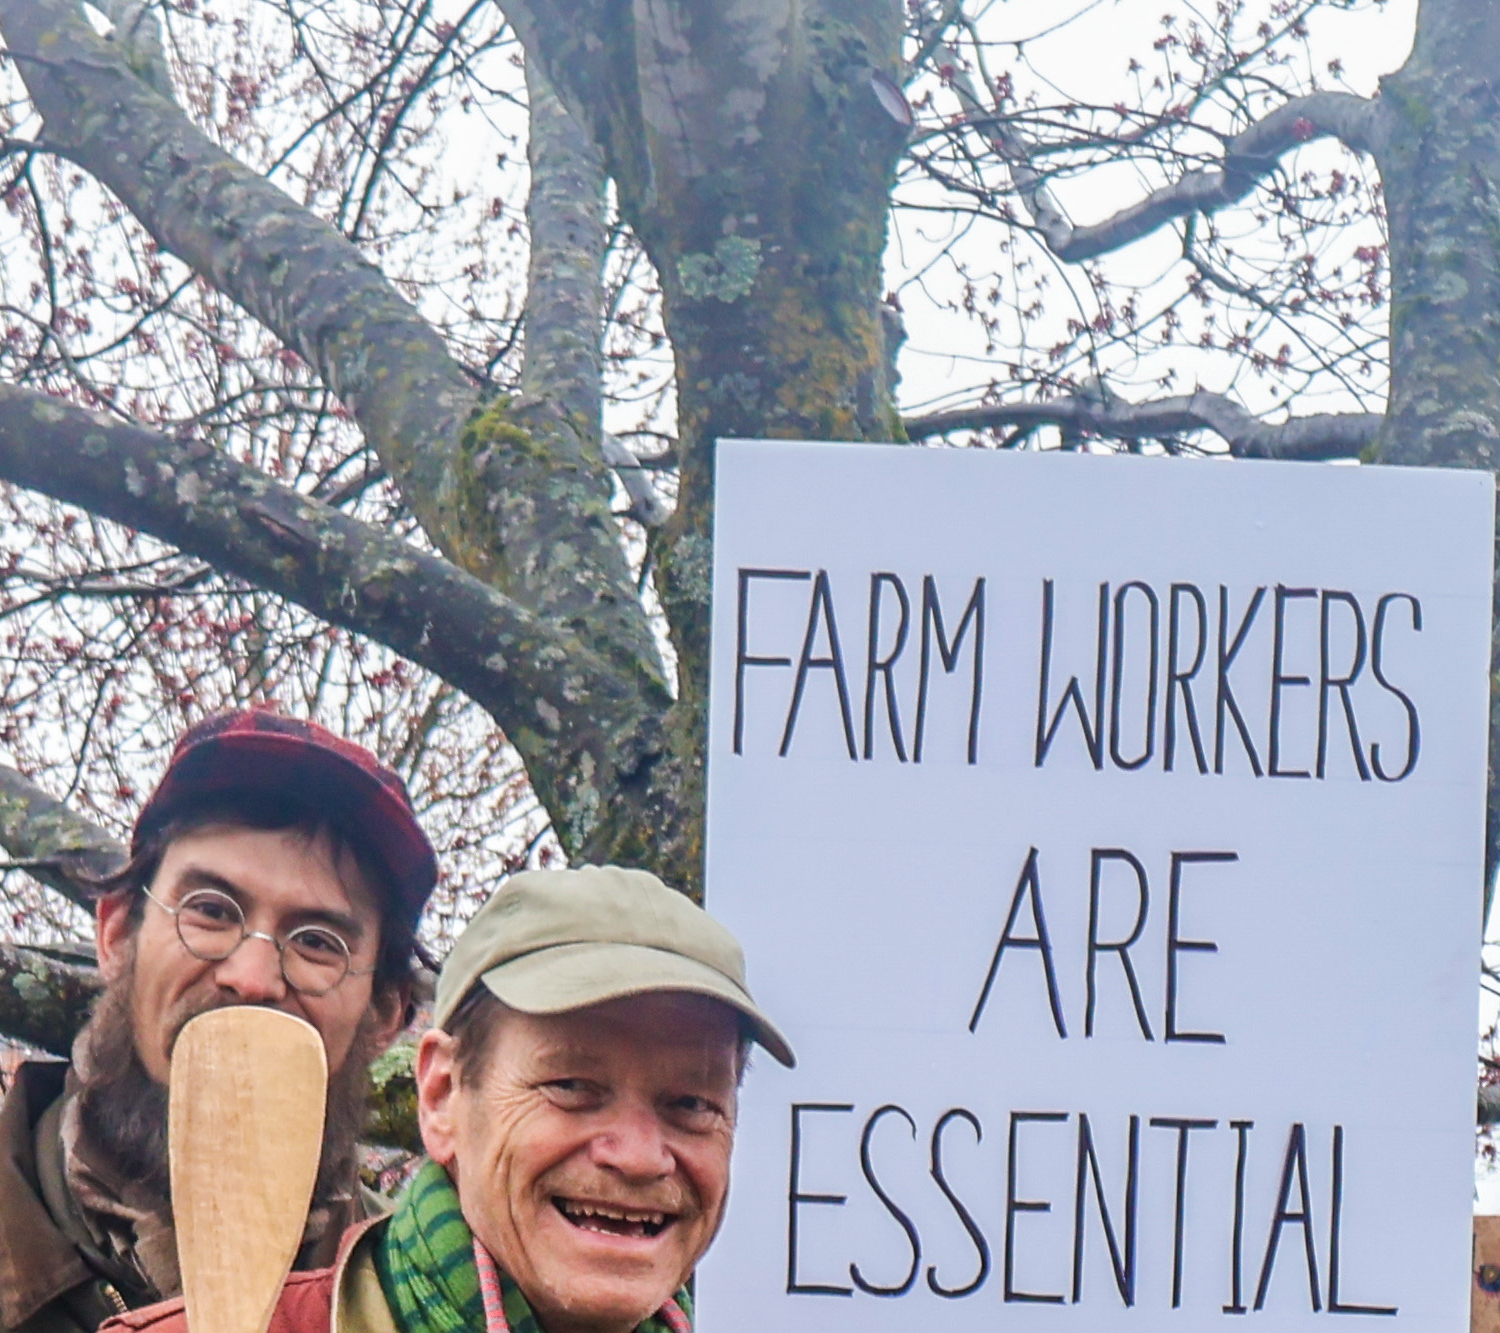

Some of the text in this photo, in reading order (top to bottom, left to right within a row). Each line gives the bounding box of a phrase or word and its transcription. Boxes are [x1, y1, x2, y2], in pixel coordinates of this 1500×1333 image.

[733, 568, 1423, 782] FARM WORKERS
[968, 846, 1240, 1044] ARE
[785, 1102, 1399, 1316] ESSENTIAL
